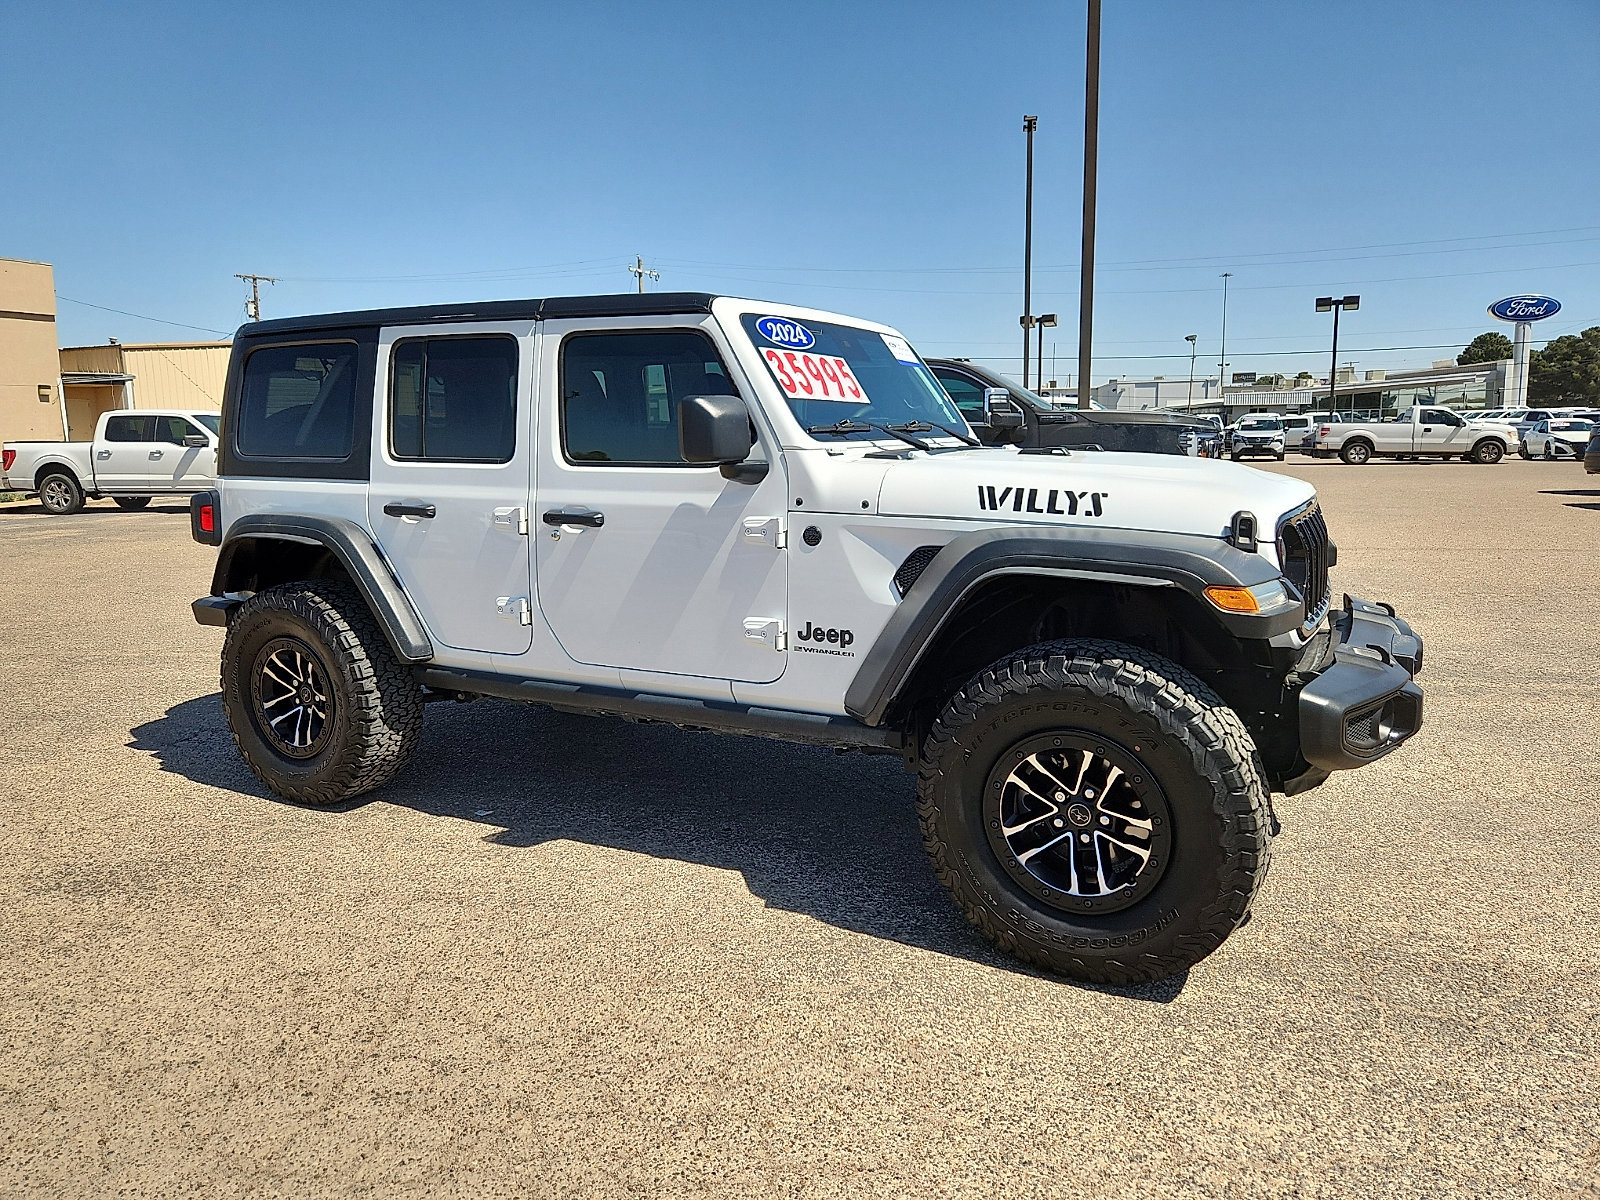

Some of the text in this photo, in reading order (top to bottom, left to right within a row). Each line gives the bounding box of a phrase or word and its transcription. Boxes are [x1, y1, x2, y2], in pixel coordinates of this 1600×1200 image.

[1506, 299, 1549, 316] Ford
[766, 321, 809, 345] 2024
[765, 349, 861, 399] 35995
[977, 485, 1109, 518] WILLYS
[797, 621, 854, 649] Jeep
[802, 646, 855, 658] WRANGLER
